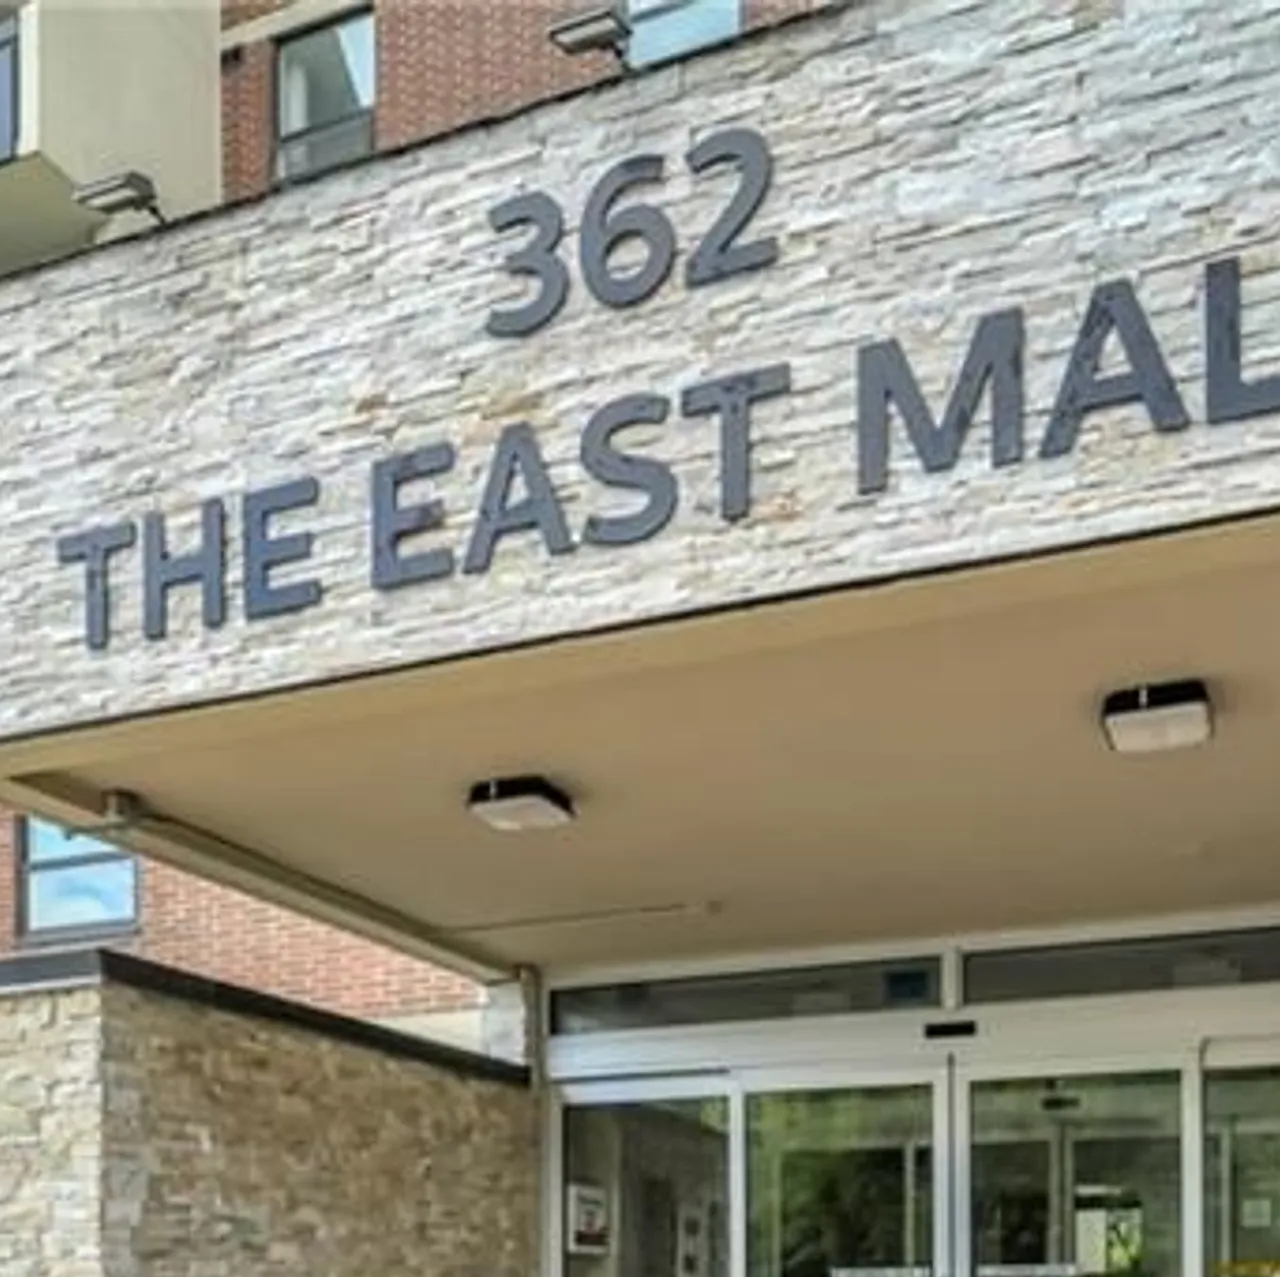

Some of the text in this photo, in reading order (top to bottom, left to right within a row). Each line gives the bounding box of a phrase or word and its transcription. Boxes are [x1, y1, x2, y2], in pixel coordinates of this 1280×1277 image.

[485, 128, 780, 340] 362
[58, 478, 322, 652] THE
[371, 362, 792, 592] EAST
